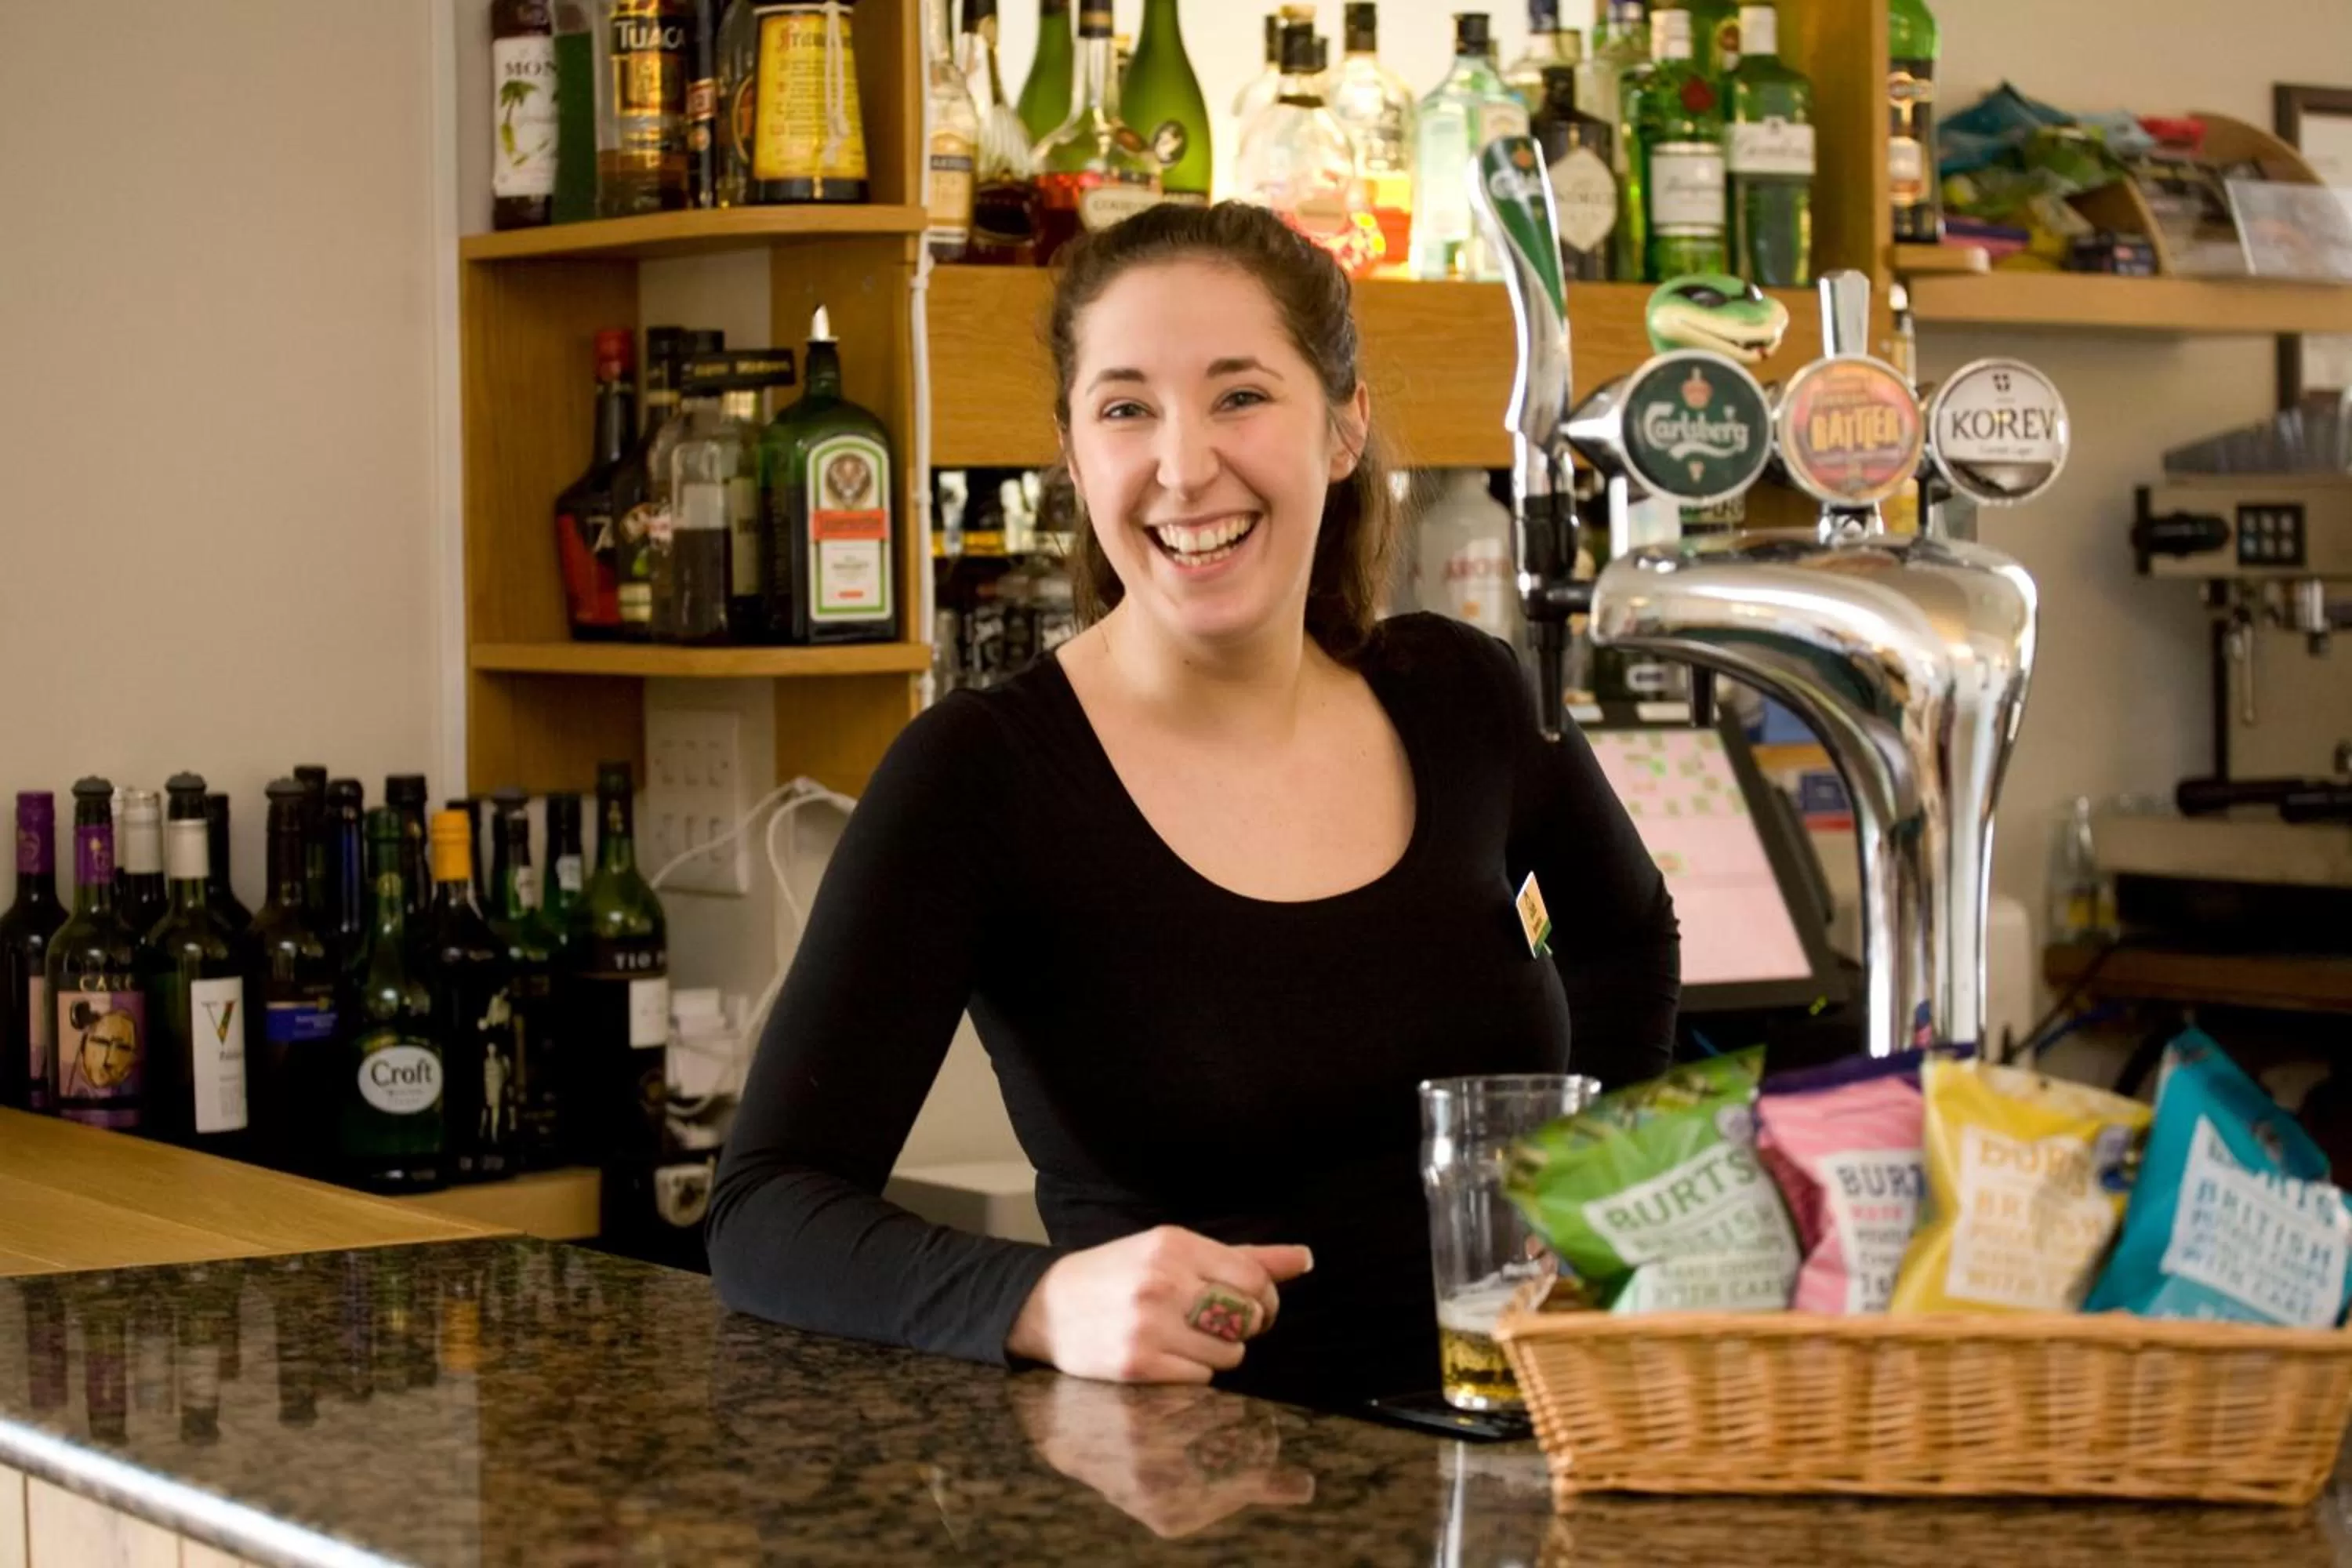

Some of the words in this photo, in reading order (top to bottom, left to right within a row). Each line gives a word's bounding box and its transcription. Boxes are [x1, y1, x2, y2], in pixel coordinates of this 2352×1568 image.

[1643, 401, 1750, 459] Carlsberg
[1951, 407, 2056, 441] KOREV
[614, 951, 652, 970] TIO
[370, 1057, 433, 1087] Croft
[1604, 1148, 1758, 1231] BURTS
[2198, 1179, 2332, 1271] BRITISH
